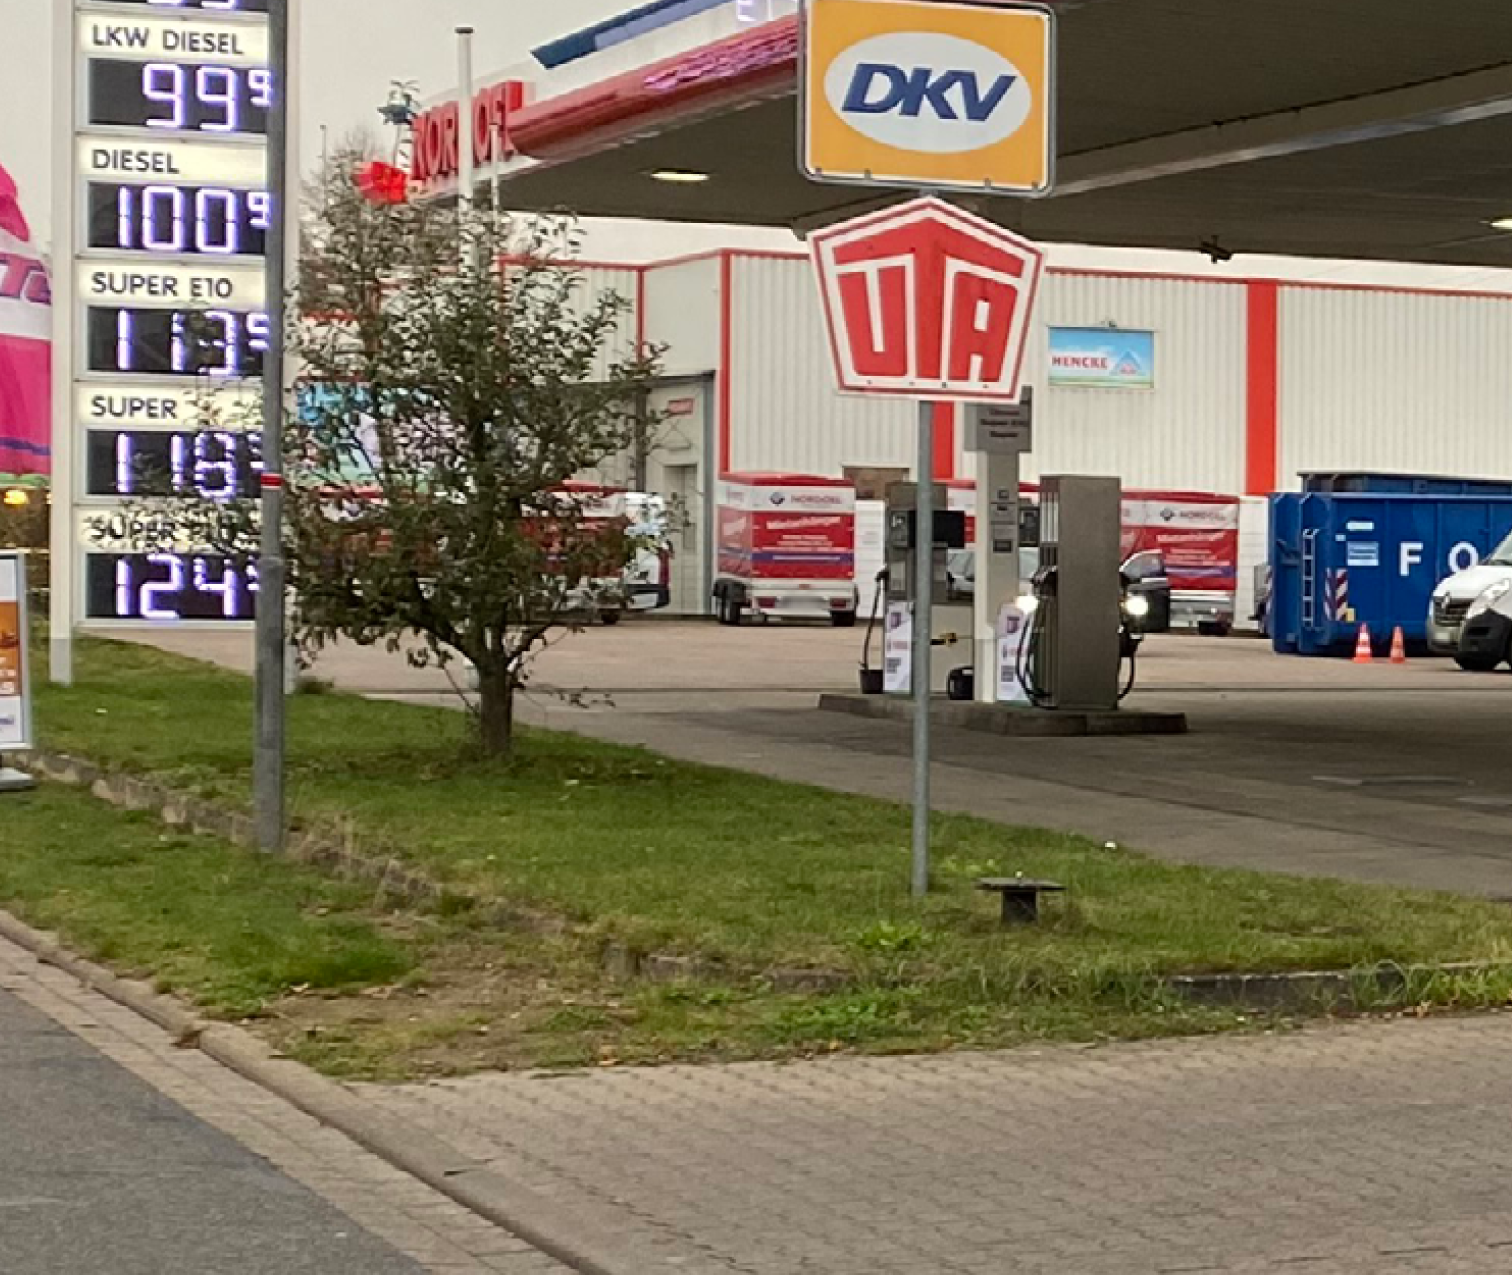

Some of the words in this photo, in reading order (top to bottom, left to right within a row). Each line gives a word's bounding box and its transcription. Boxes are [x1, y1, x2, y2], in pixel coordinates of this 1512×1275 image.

[93, 25, 149, 49] LKW
[162, 29, 243, 55] DIESEL
[841, 63, 1016, 122] DKV
[92, 149, 180, 174] DIESEL
[92, 272, 179, 297] SUPER
[190, 277, 233, 298] E10
[833, 216, 1027, 384] UTA
[91, 395, 178, 419] SUPER
